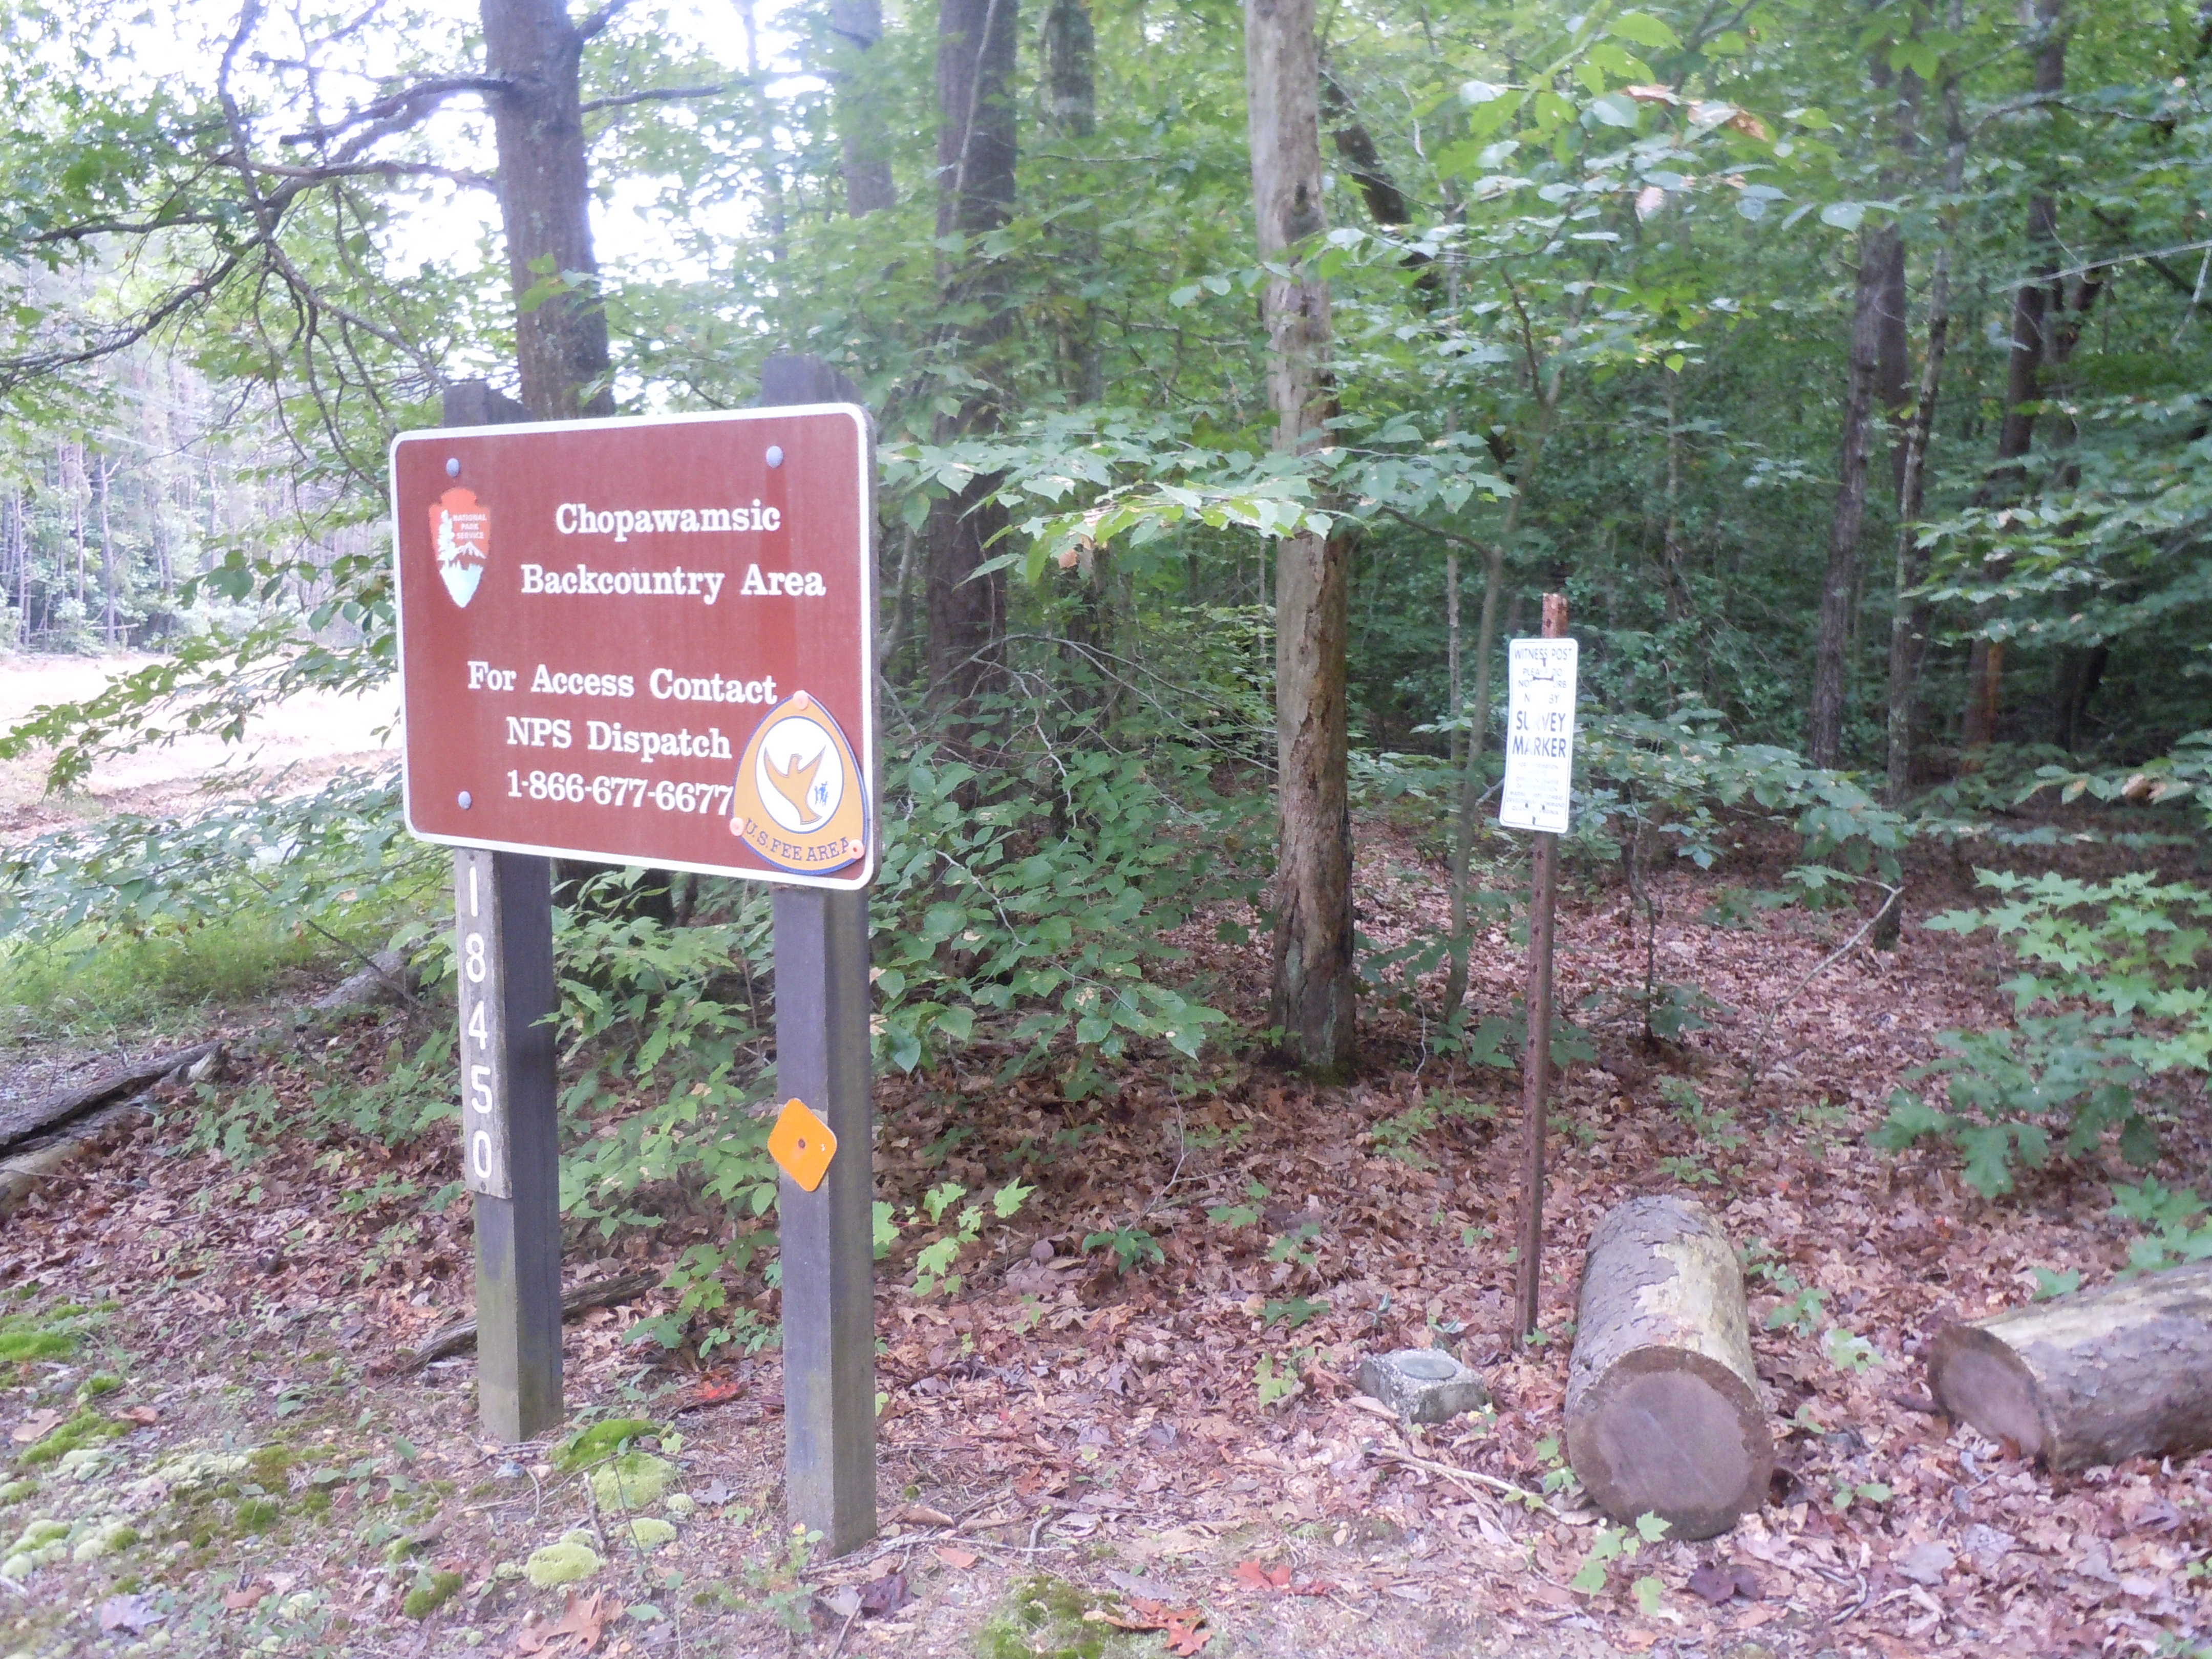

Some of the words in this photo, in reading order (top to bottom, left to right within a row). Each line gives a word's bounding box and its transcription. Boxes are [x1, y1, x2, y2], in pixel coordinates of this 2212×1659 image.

[556, 499, 781, 542] Chopawamsic
[521, 564, 725, 605] Backcountry
[740, 564, 826, 597] Area
[1514, 648, 1547, 660] WITNESS
[1551, 648, 1572, 661] POST
[467, 661, 517, 691] For
[530, 664, 635, 698] Access
[649, 668, 778, 705] Contact
[506, 716, 572, 749] NPS
[587, 721, 733, 763] Dispatch
[1516, 710, 1566, 733] SUVEY
[1512, 735, 1566, 758] MARKER
[507, 769, 734, 816] 1-866-677-6677
[746, 818, 768, 848] U.S.
[770, 838, 802, 861] FEE
[806, 836, 850, 861] AREA
[465, 865, 493, 1180] 18450
